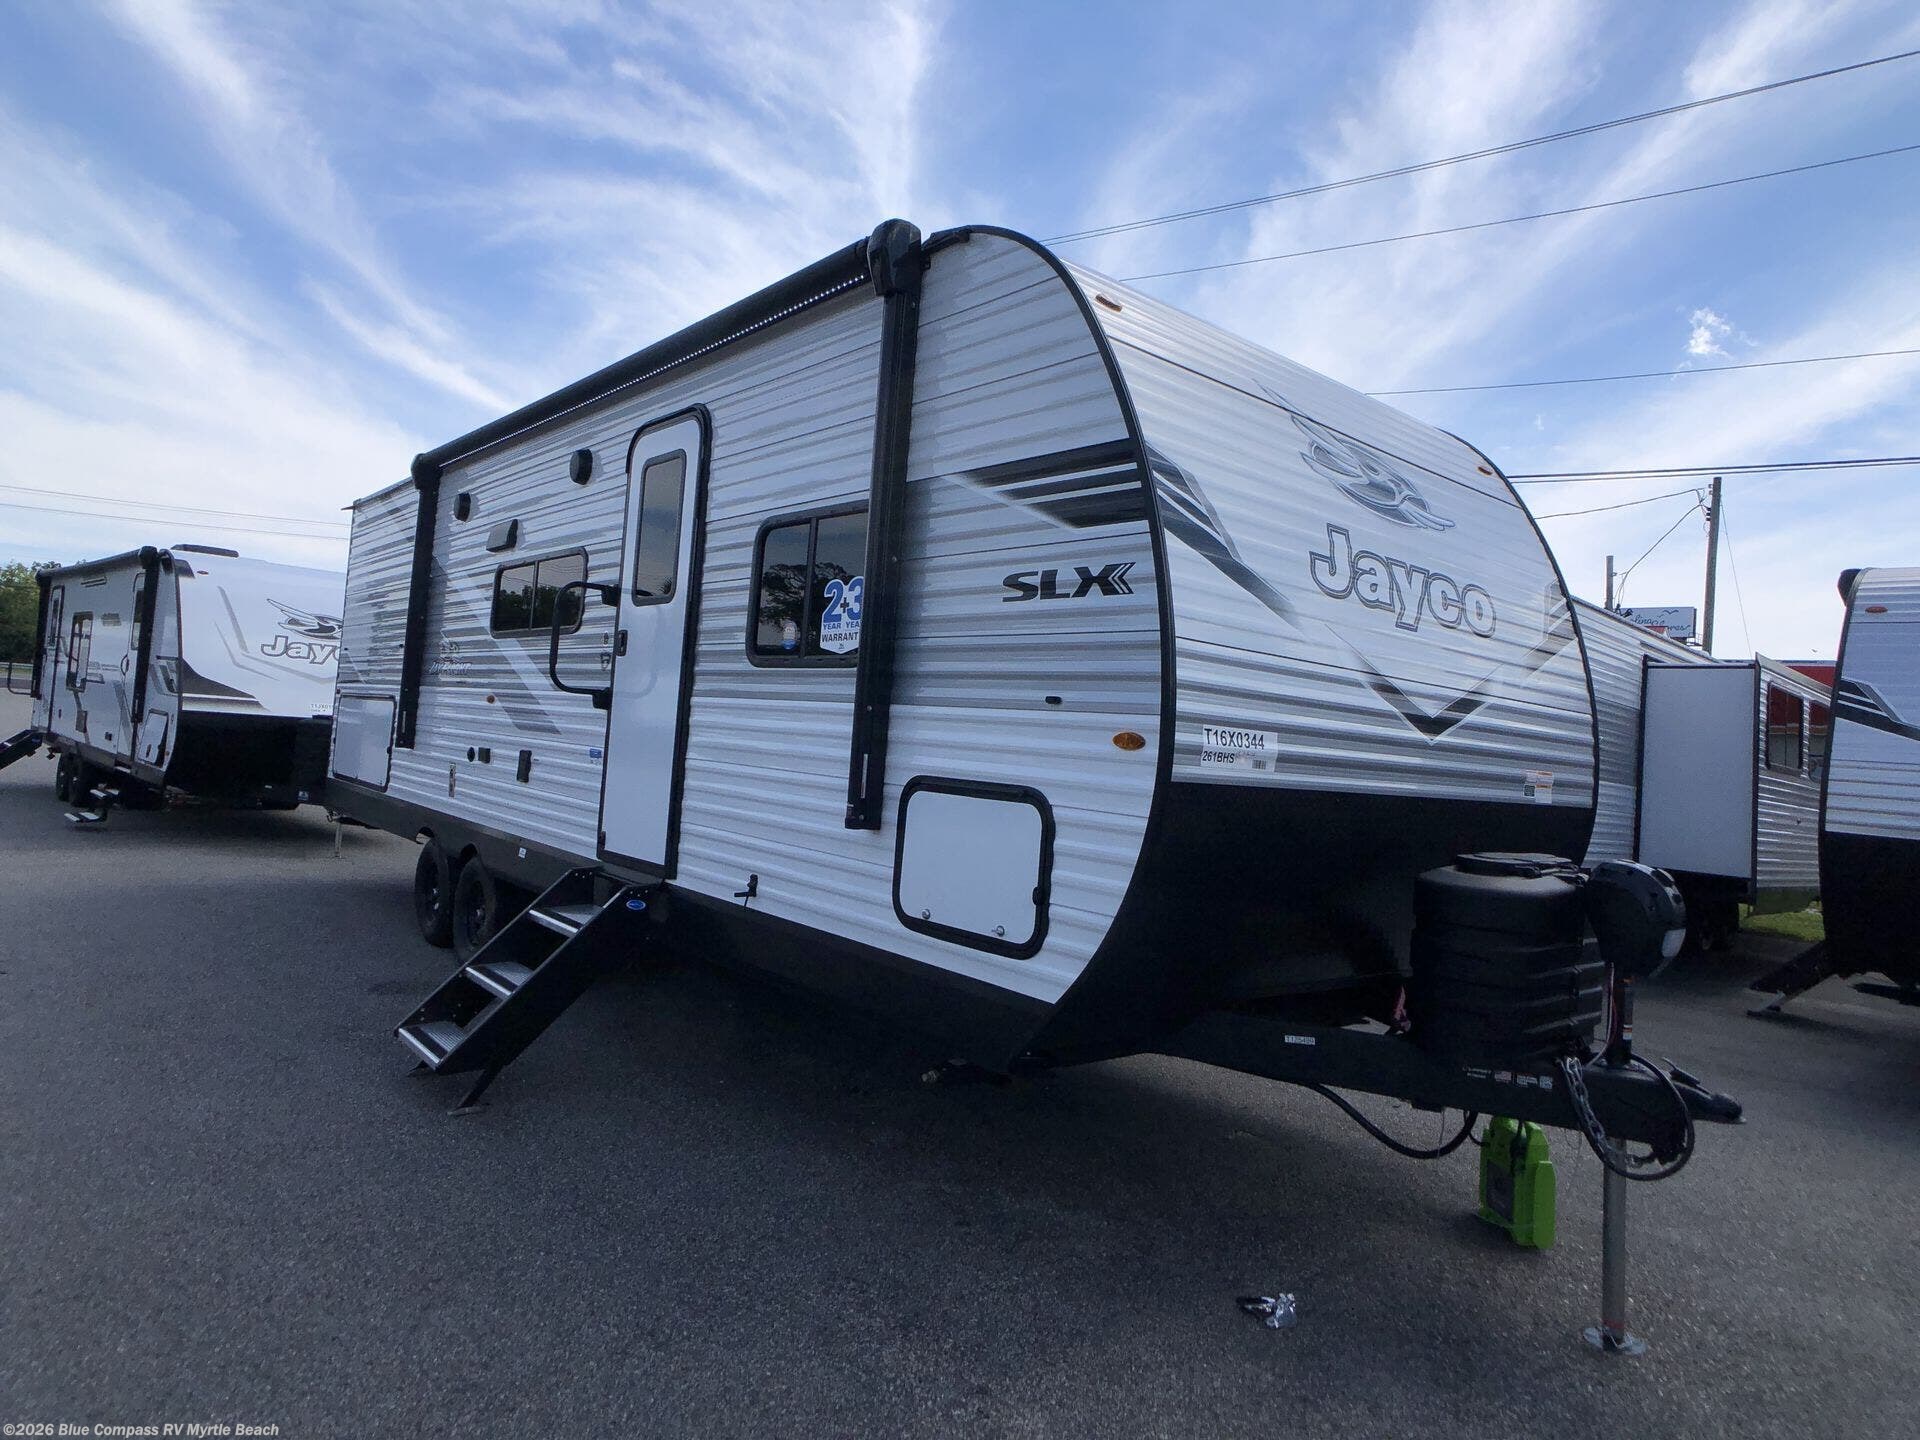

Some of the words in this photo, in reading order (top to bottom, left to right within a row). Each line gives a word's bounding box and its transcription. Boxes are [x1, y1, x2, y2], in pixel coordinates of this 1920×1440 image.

[1002, 562, 1136, 602] SLX
[1309, 523, 1496, 638] Jayco
[823, 622, 841, 630] YEAR
[846, 620, 861, 629] YEA
[822, 632, 858, 642] WARRANT
[261, 635, 340, 664] Jay
[1204, 728, 1264, 750] T16X0344
[1202, 750, 1235, 763] 261BHS
